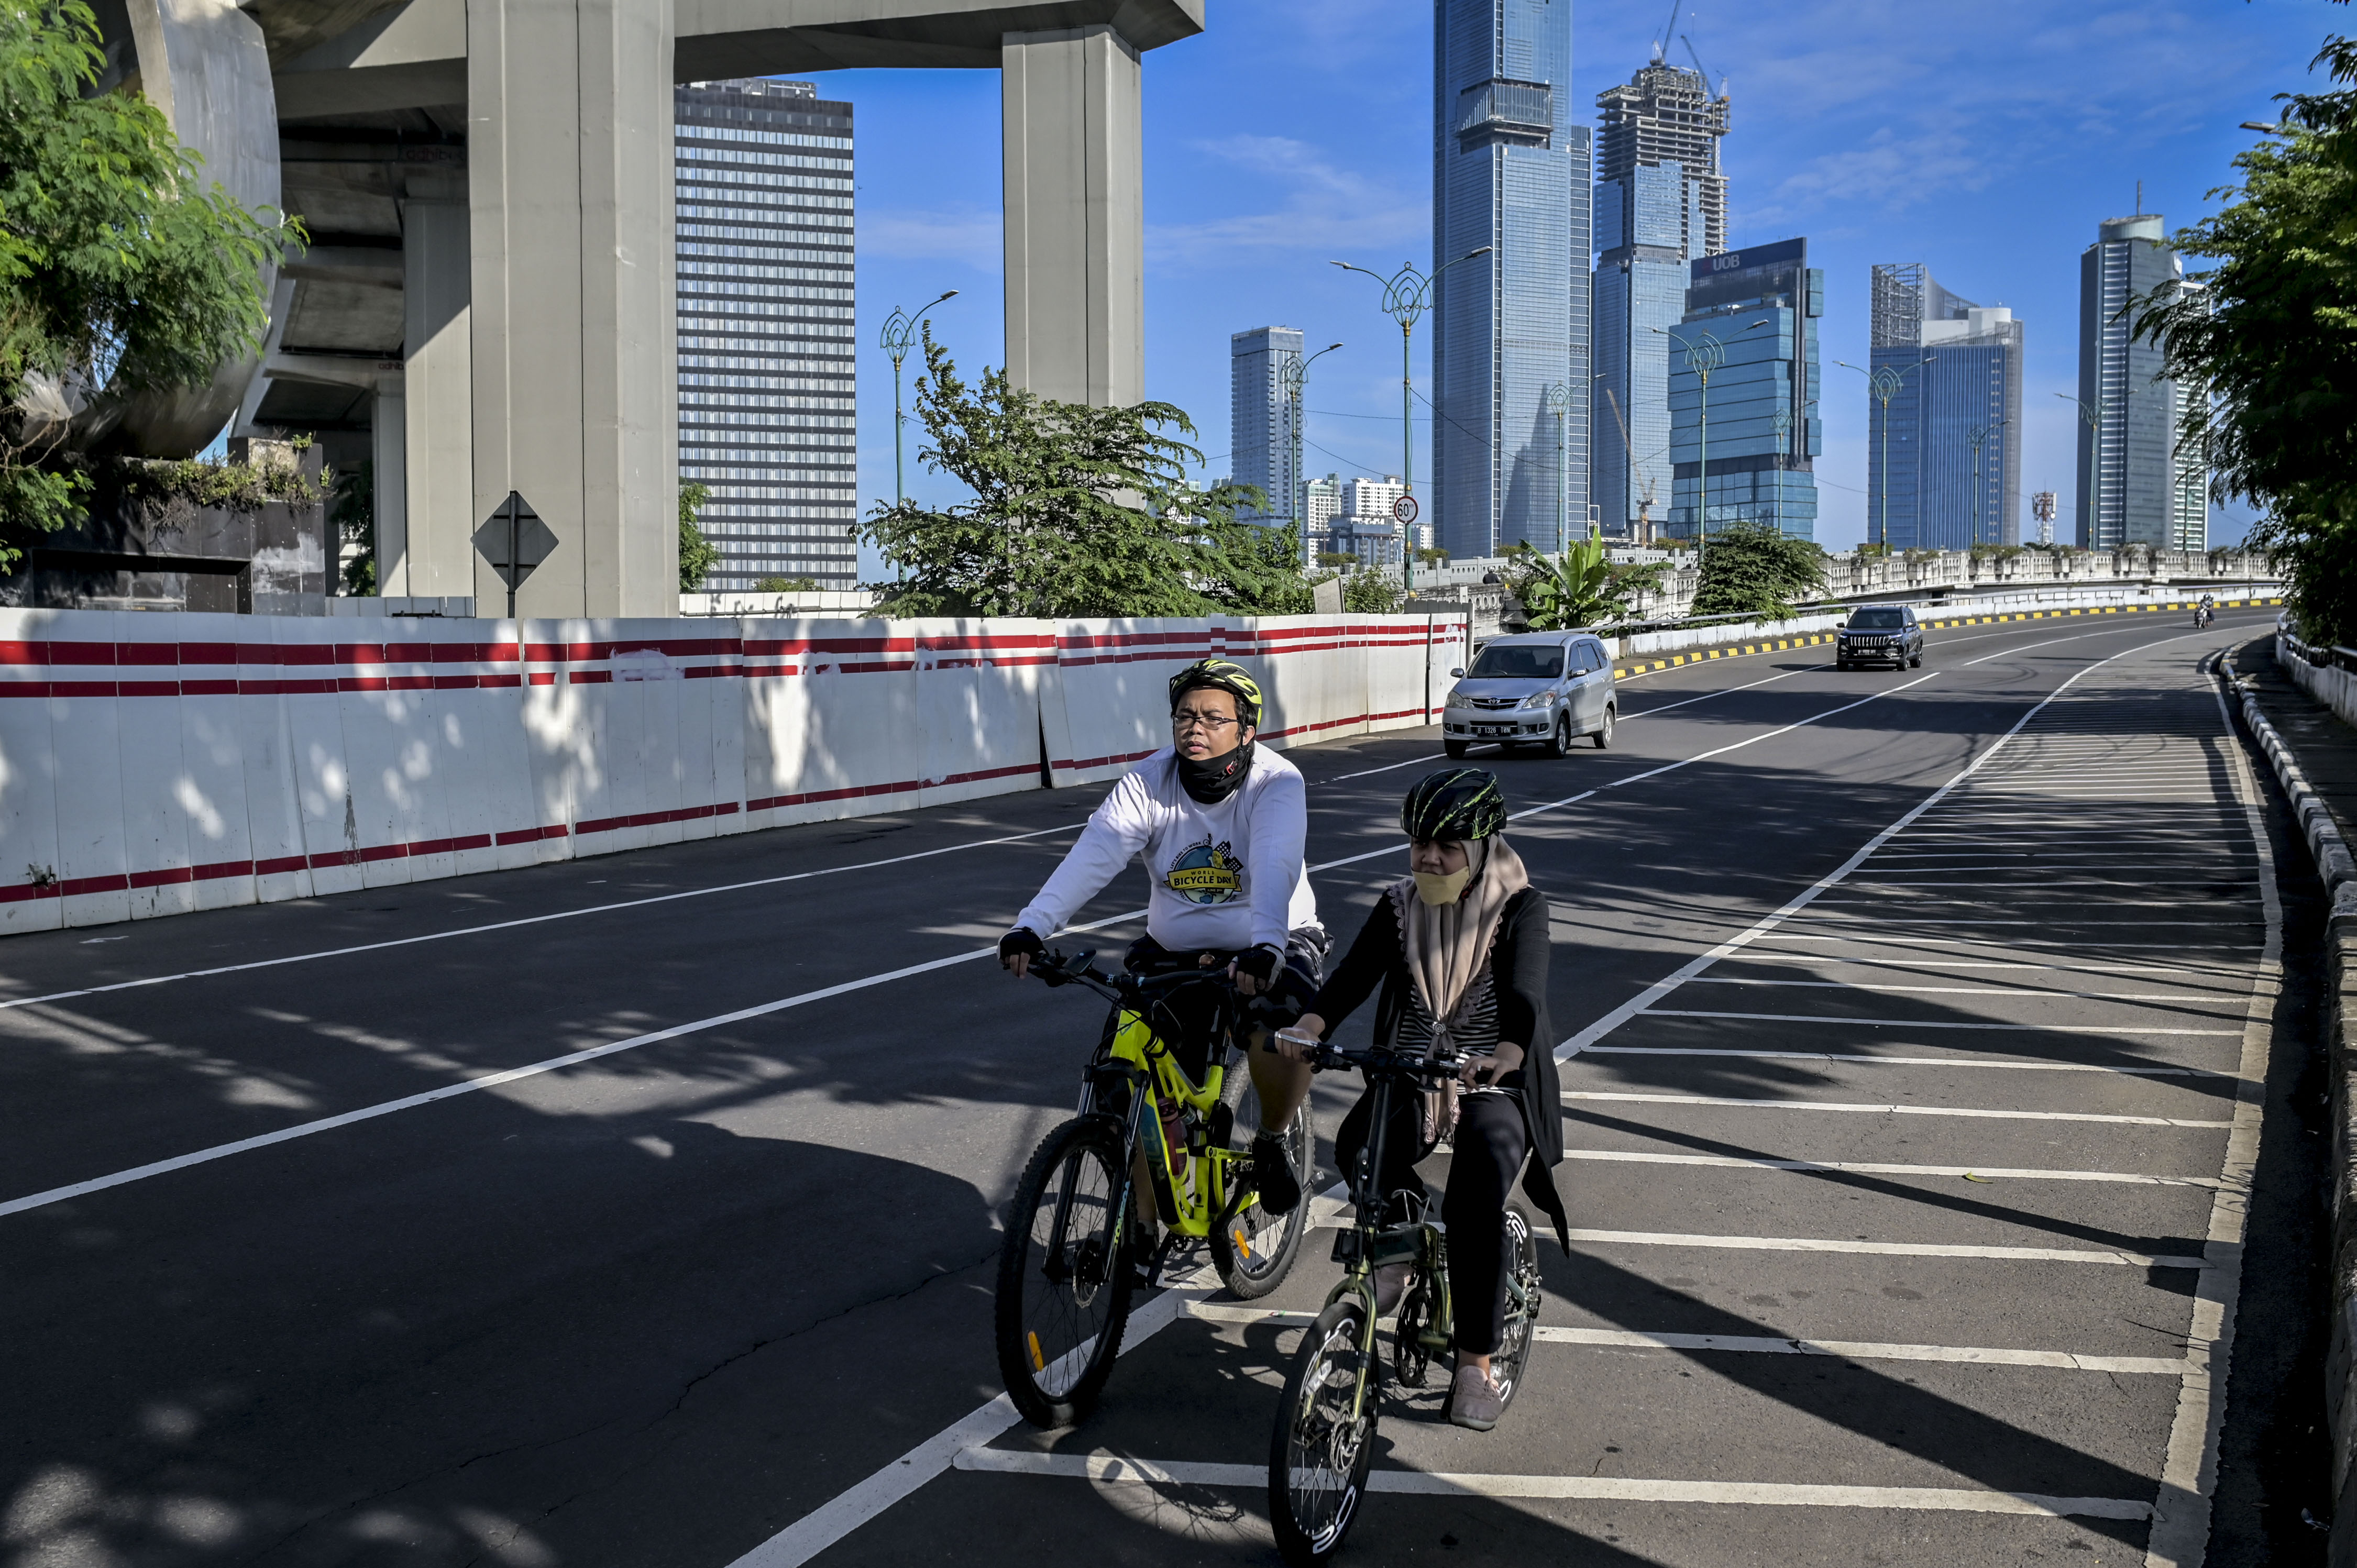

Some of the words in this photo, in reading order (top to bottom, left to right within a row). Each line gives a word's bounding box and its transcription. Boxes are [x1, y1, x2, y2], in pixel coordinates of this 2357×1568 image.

[1713, 255, 1739, 271] UOB
[1397, 503, 1409, 516] 60
[1175, 851, 1184, 859] BIKE
[1174, 876, 1214, 886] BICYCLE
